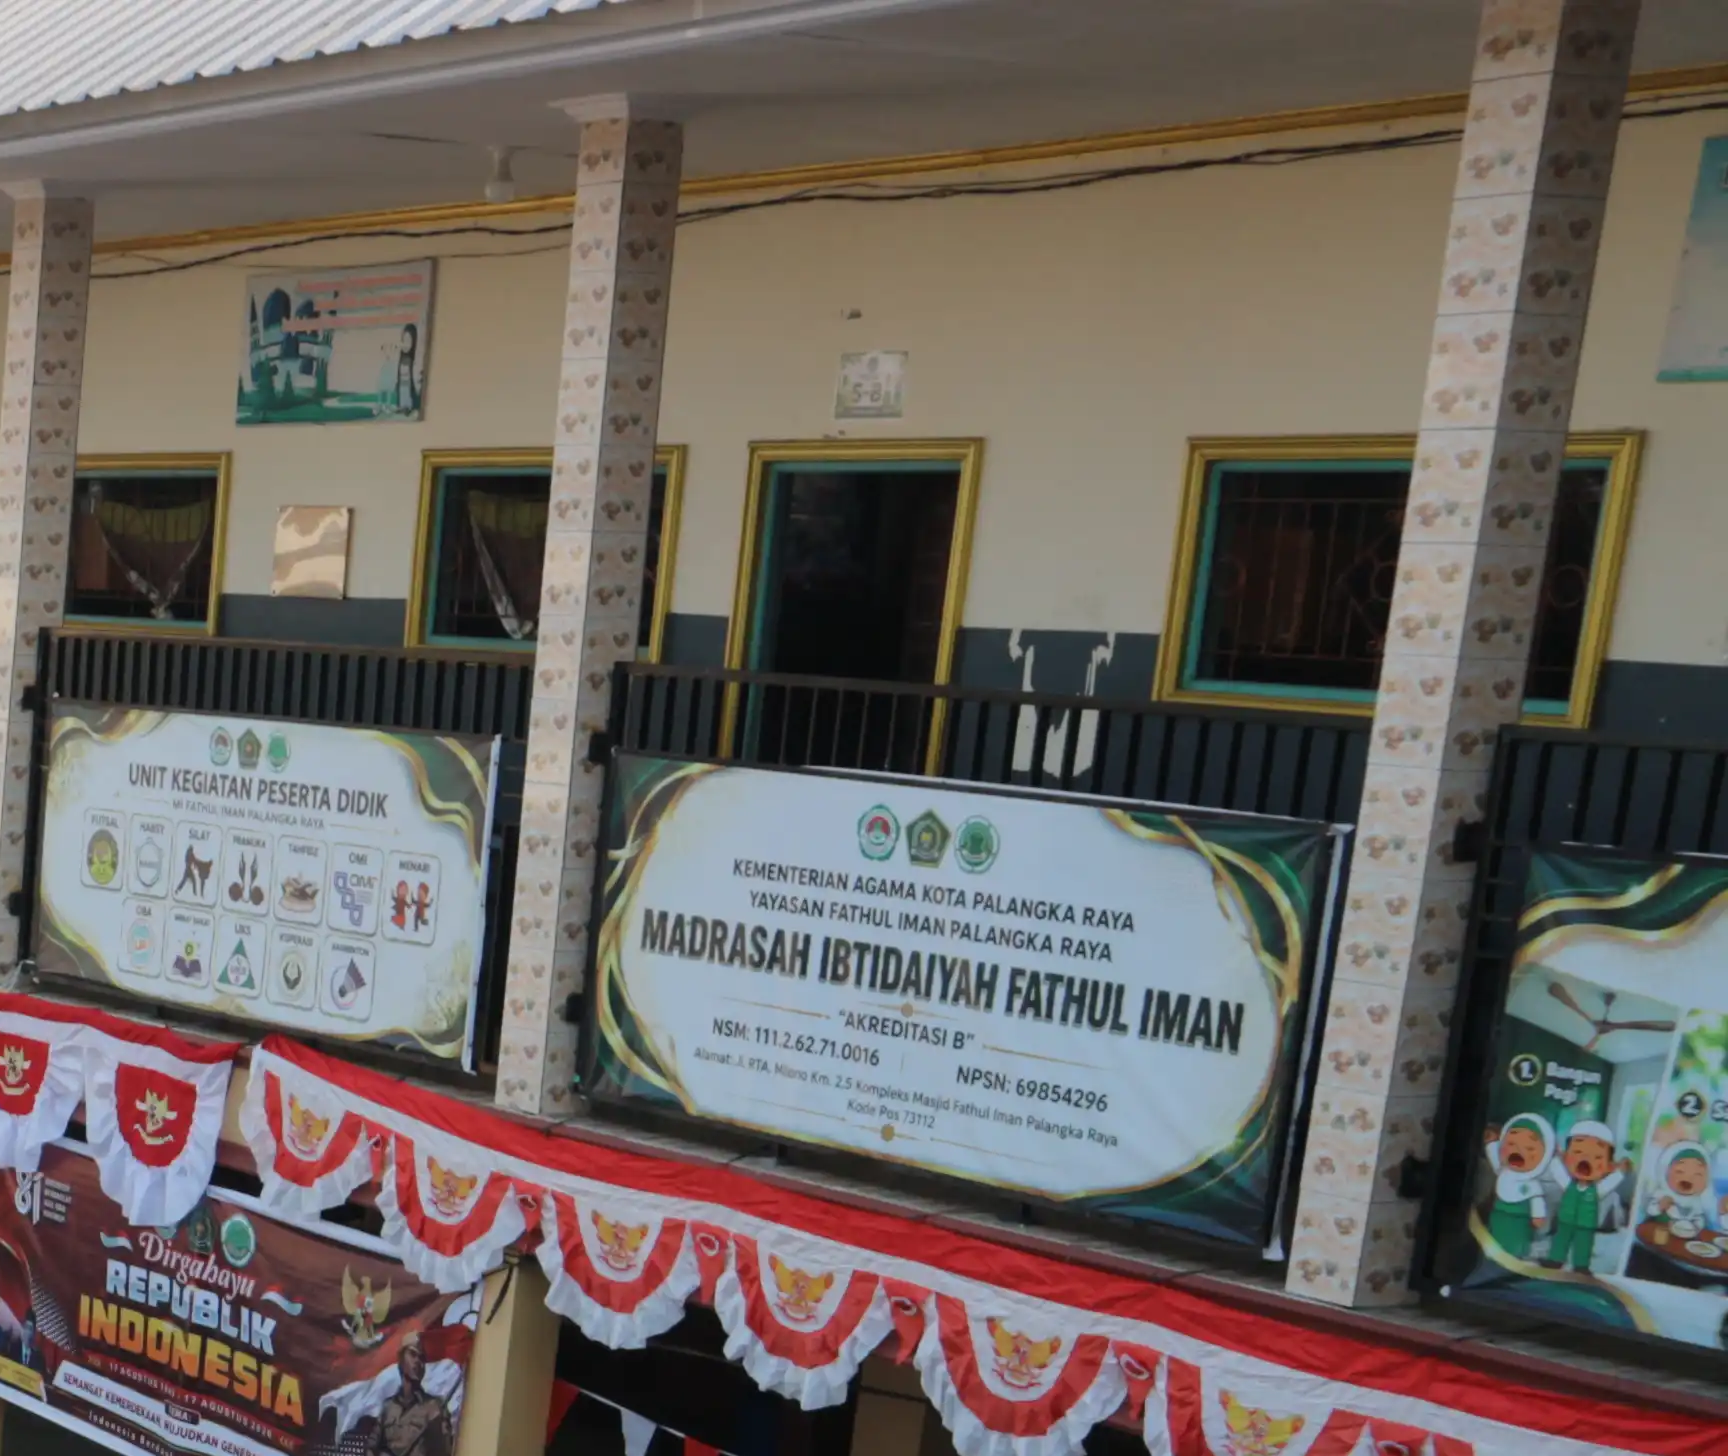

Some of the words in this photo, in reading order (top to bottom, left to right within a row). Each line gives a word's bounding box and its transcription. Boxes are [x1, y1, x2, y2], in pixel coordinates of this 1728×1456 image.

[129, 762, 167, 790] UNIT
[171, 768, 254, 801] KEGIATAN
[256, 778, 332, 811] PESERTA
[336, 788, 389, 818] DIDIK
[172, 800, 184, 811] MI
[185, 802, 219, 816] FATHUL
[221, 806, 245, 819] IMAN
[247, 808, 299, 827] PALANGKA
[301, 815, 325, 830] RAYA
[90, 814, 120, 829] FUTSAL
[188, 829, 211, 842] SILAT
[348, 853, 368, 866] OMI
[398, 860, 431, 874] MENARI
[733, 859, 849, 892] KEMENTERIAN
[852, 875, 917, 901] AGAMA
[922, 885, 967, 908] KOTA
[972, 891, 1076, 925] PALANGKA
[1082, 906, 1136, 933] RAYA
[748, 890, 825, 918] YAYASAN
[829, 901, 894, 930] FATHUL
[897, 912, 945, 937] IMAN
[950, 919, 1055, 953] PALANGKA
[1059, 935, 1114, 963] RAYA
[640, 907, 812, 980] MADRASAH
[817, 936, 1000, 1014] IBTIDAIYAH
[1004, 965, 1131, 1037] FATHUL
[1138, 987, 1245, 1055] IMAN
[712, 1017, 750, 1042] NSM:
[754, 1026, 881, 1067] 111.2.62.71.0016
[694, 1047, 733, 1066] Alamat:
[774, 1062, 808, 1082] Milono
[856, 1079, 910, 1102] Kompleks
[912, 1091, 950, 1113] Masjid
[952, 1101, 991, 1121] Fathul
[993, 1108, 1023, 1127] Iman
[1026, 1115, 1084, 1141] Palangka
[1087, 1127, 1120, 1149] Raya
[955, 1064, 1012, 1094] NPSN:
[1015, 1079, 1109, 1113] 69854296
[1544, 1083, 1578, 1106] Pagi
[1546, 1061, 1602, 1087] Bangun
[846, 1100, 876, 1117] Kode
[879, 1104, 900, 1122] Pos
[902, 1110, 936, 1130] 73112
[138, 1231, 256, 1300] Dirgahayu
[106, 1258, 277, 1356] REPUBLIK
[79, 1293, 304, 1426] INDONESIA
[62, 1371, 104, 1399] SEMANGAT
[163, 1419, 220, 1448] WUJUDKAN
[119, 1365, 159, 1390] AGUSTUS
[200, 1398, 249, 1426] AGUSTUS
[88, 1409, 137, 1442] Indonesia
